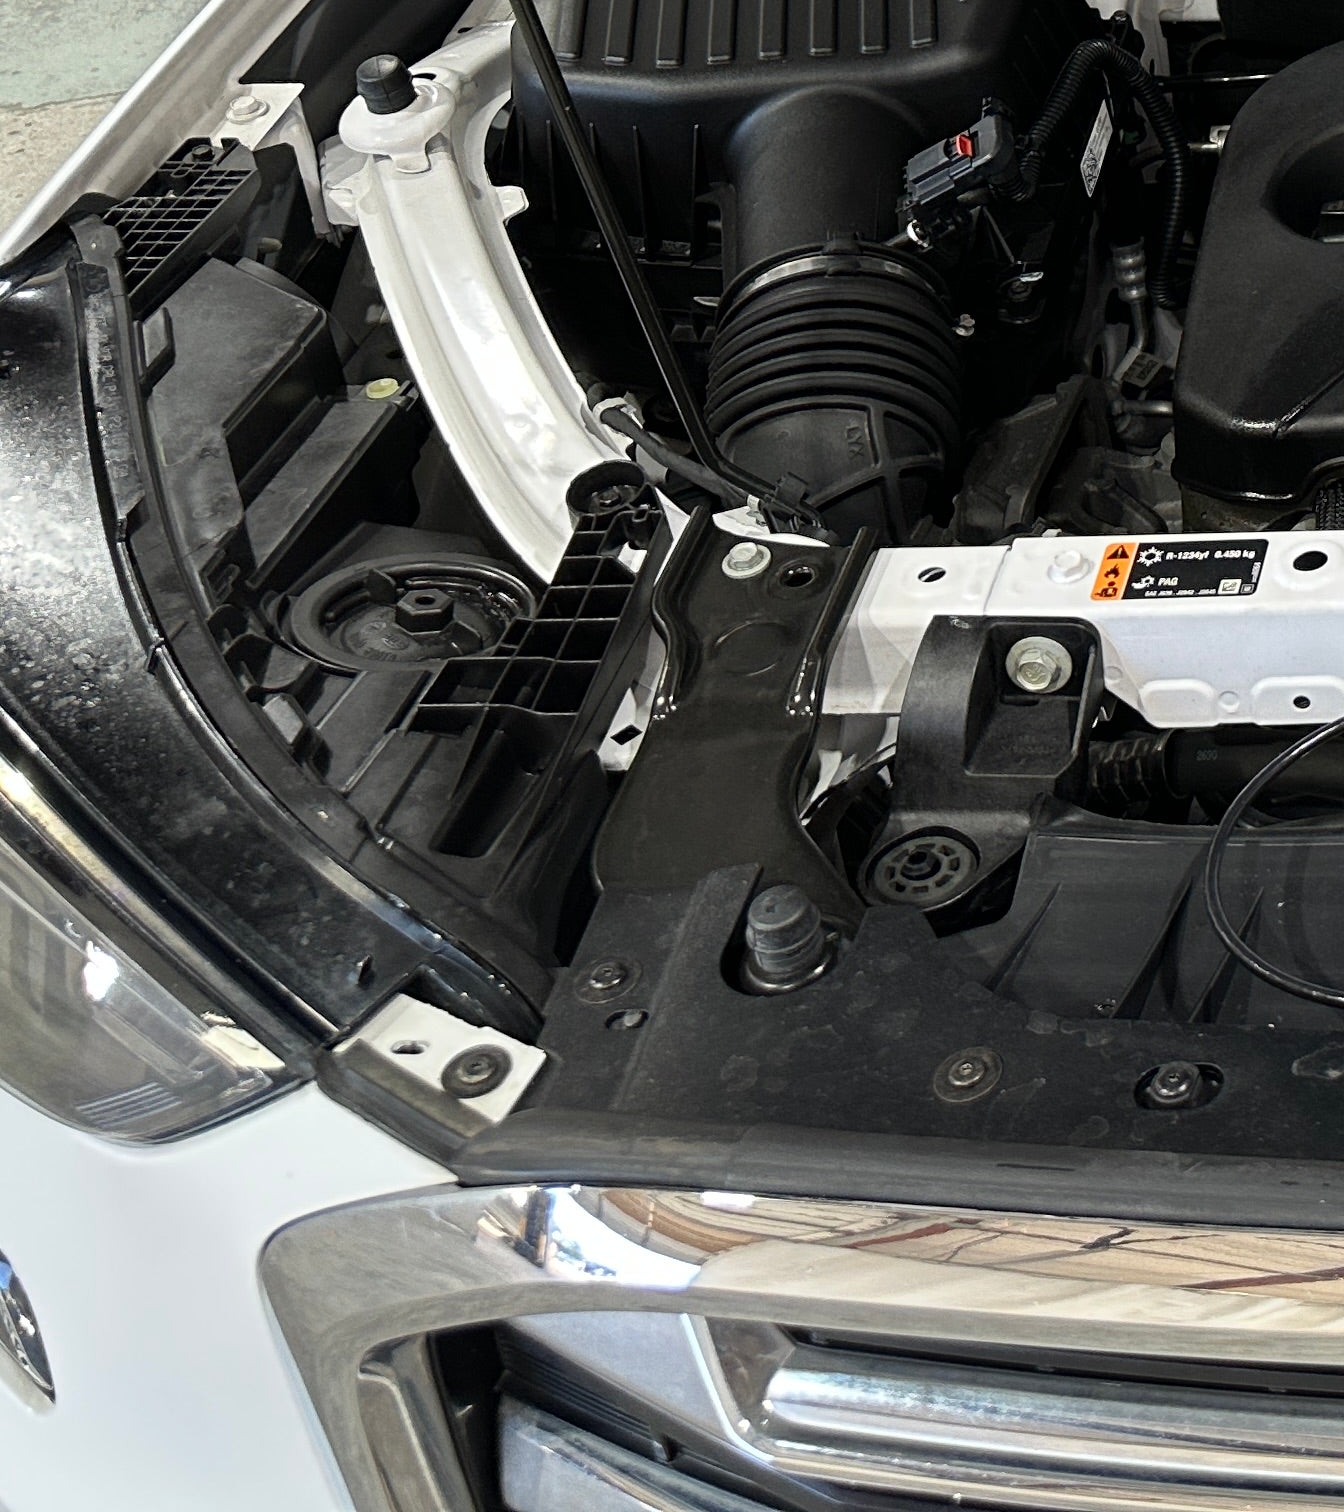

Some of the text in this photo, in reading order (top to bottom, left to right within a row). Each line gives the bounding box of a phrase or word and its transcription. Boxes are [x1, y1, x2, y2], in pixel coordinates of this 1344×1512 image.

[1165, 550, 1210, 561] R-1234yf
[1241, 549, 1256, 559] kg
[1157, 576, 1179, 586] PAG
